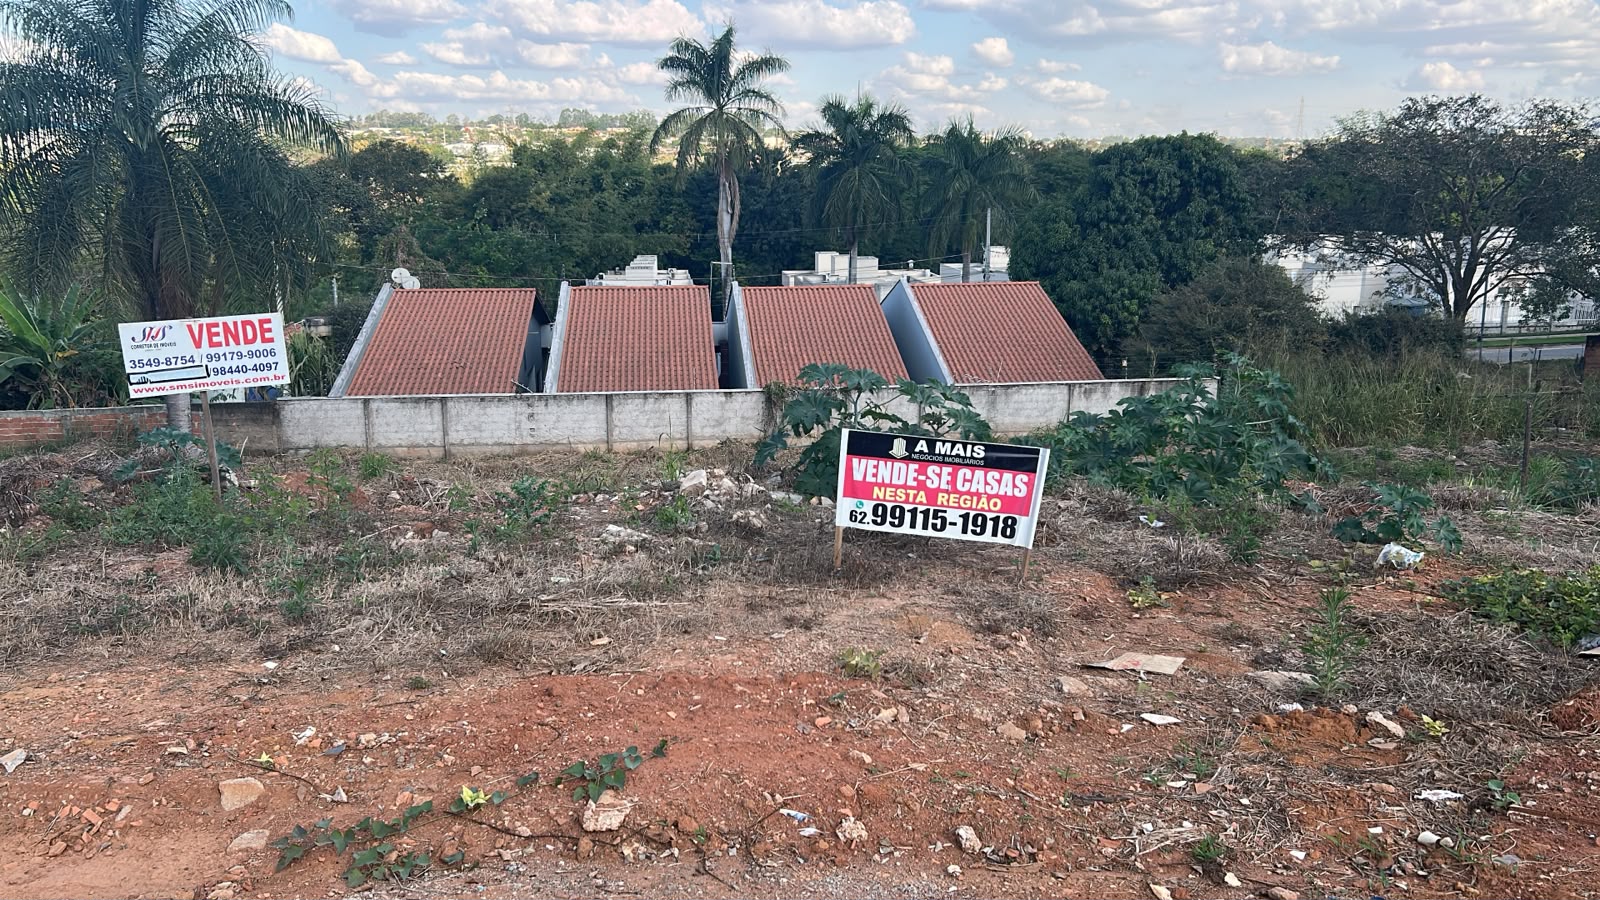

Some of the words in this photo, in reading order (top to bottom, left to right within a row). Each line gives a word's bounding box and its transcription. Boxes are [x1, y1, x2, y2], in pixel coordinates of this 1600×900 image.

[186, 317, 275, 349] VENDE
[129, 354, 196, 369] 3549-8754
[206, 348, 277, 363] 99179-9006
[133, 374, 287, 394] www.smsimoveis.com.br
[911, 453, 943, 462] NEGÓCIOS
[944, 455, 985, 466] IMOBILIÁRIOS
[914, 439, 930, 453] A
[934, 441, 986, 459] MAIS
[852, 457, 953, 490] VENDE-SE
[956, 468, 1029, 498] CASAS
[872, 486, 927, 504] NESTA
[937, 491, 1002, 511] REGIÃO
